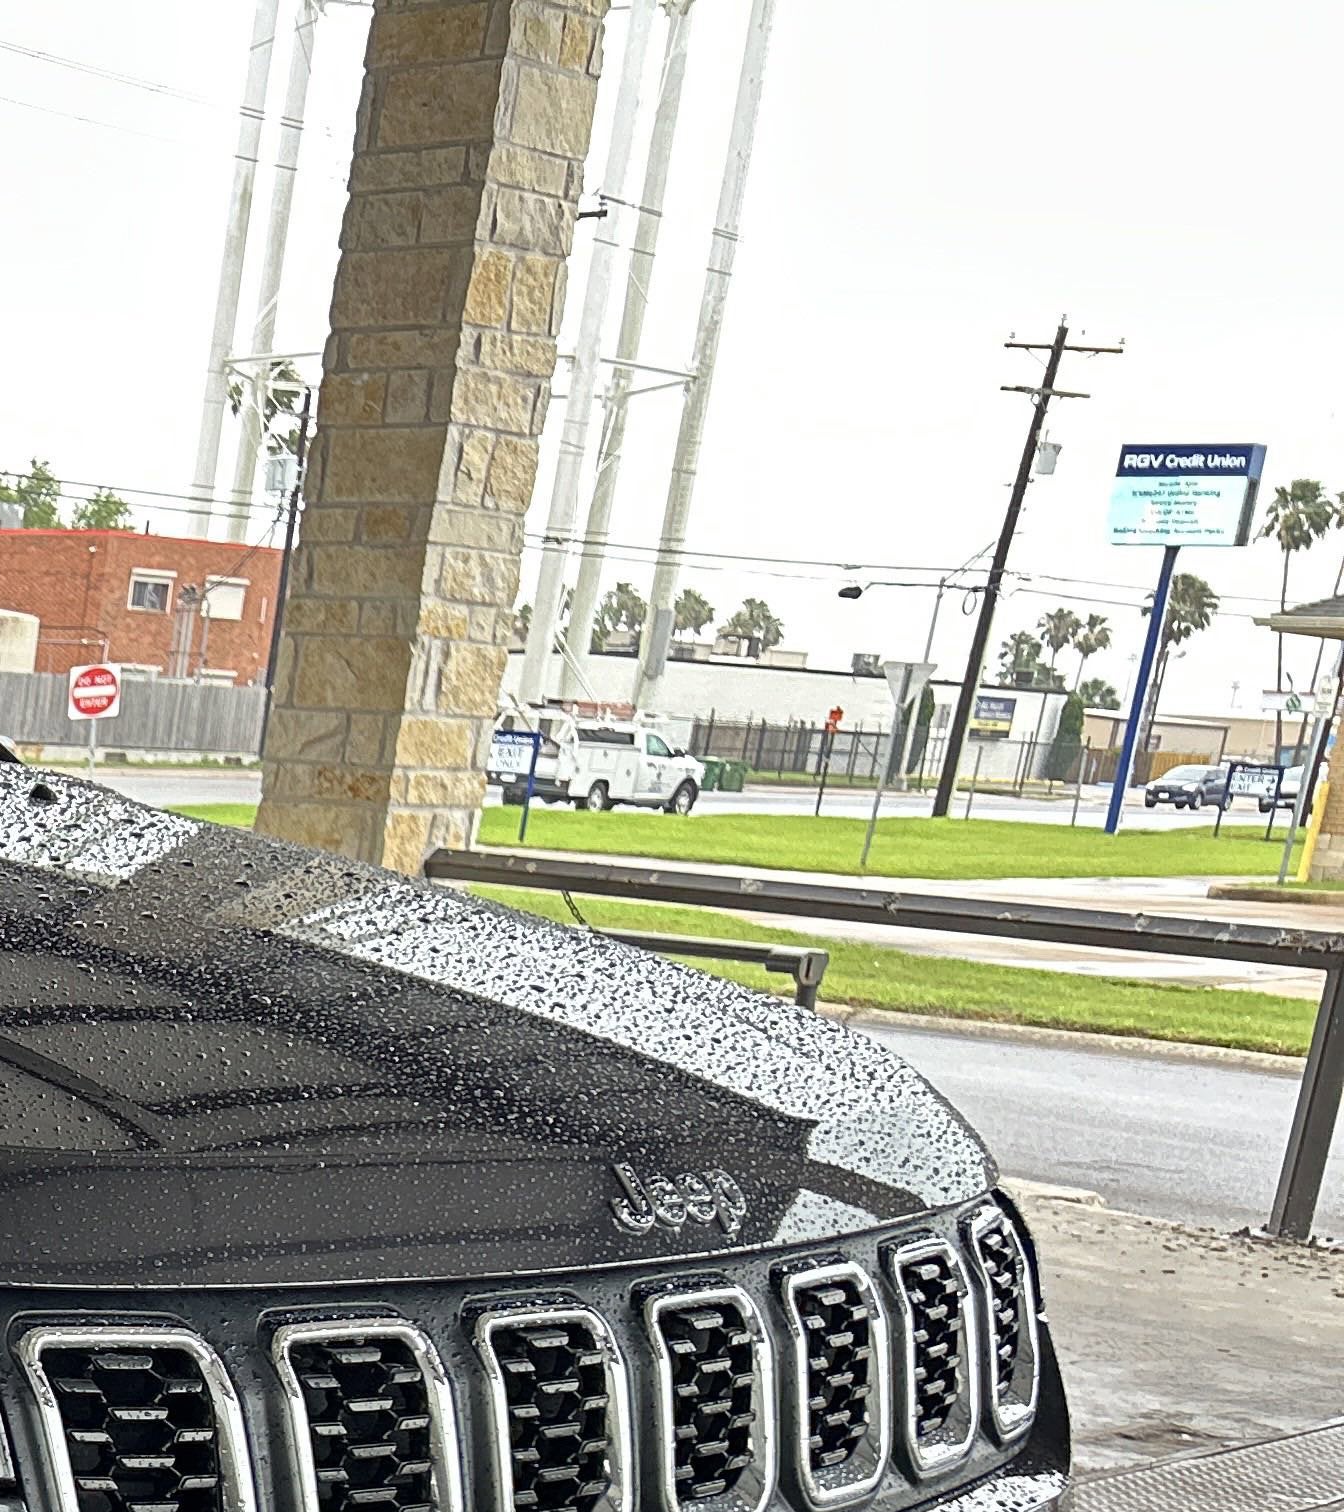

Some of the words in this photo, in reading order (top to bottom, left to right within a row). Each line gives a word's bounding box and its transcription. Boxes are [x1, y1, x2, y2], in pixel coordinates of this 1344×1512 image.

[1123, 453, 1164, 469] RGV
[1165, 453, 1206, 469] Credit
[1207, 454, 1246, 468] Union
[613, 1161, 747, 1235] Jeep
